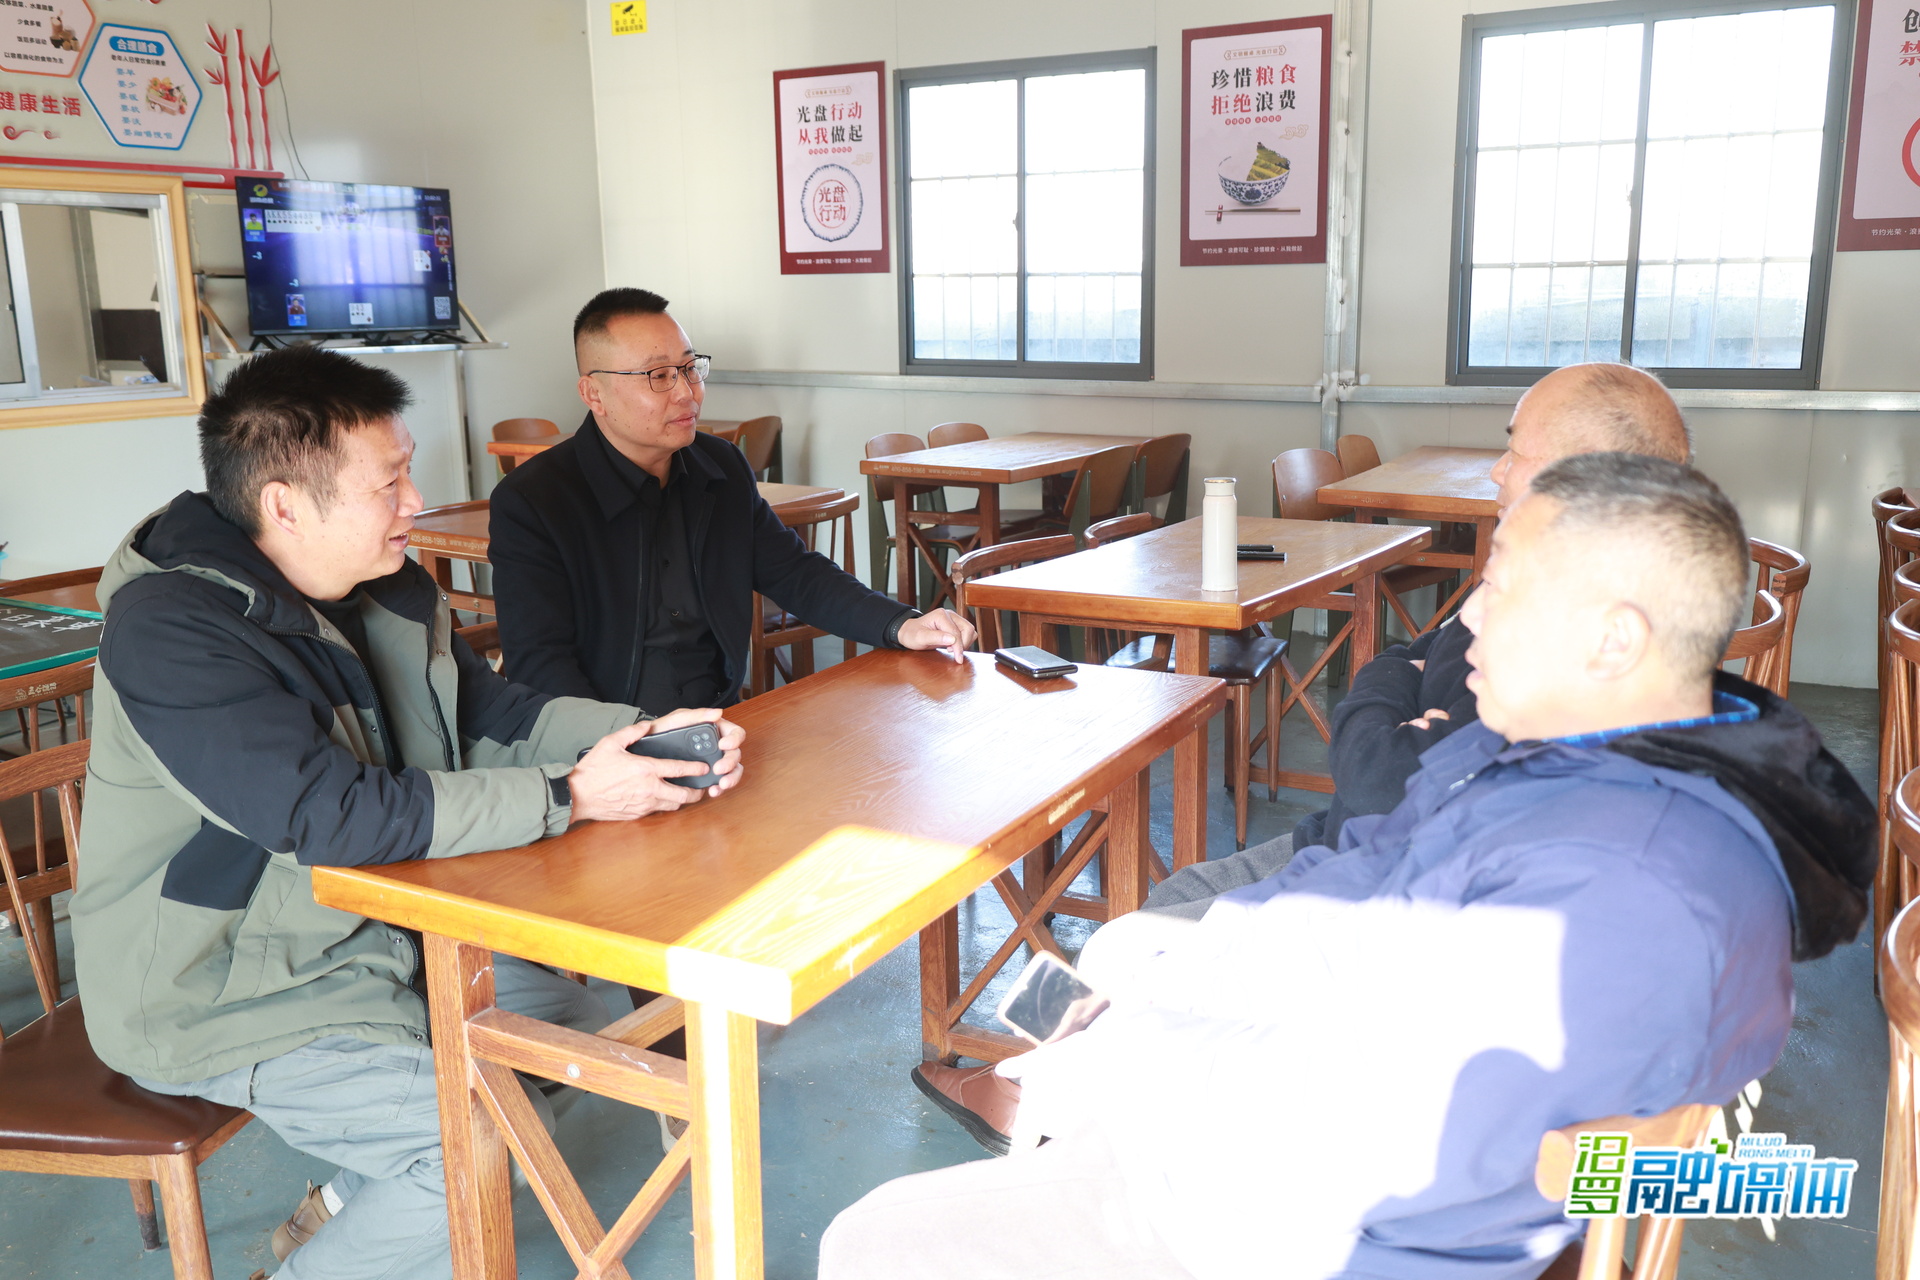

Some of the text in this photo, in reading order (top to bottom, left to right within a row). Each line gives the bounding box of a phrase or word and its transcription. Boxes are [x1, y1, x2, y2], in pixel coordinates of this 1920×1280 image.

[1898, 40, 1920, 66] 禁
[1211, 63, 1297, 90] 珍惜粮食
[0, 91, 82, 117] 健康生活
[797, 101, 863, 124] 光盘行动
[1211, 89, 1297, 116] 拒绝浪费
[798, 124, 863, 145] 从我做起
[819, 186, 846, 203] 光盘
[819, 204, 846, 222] 行动
